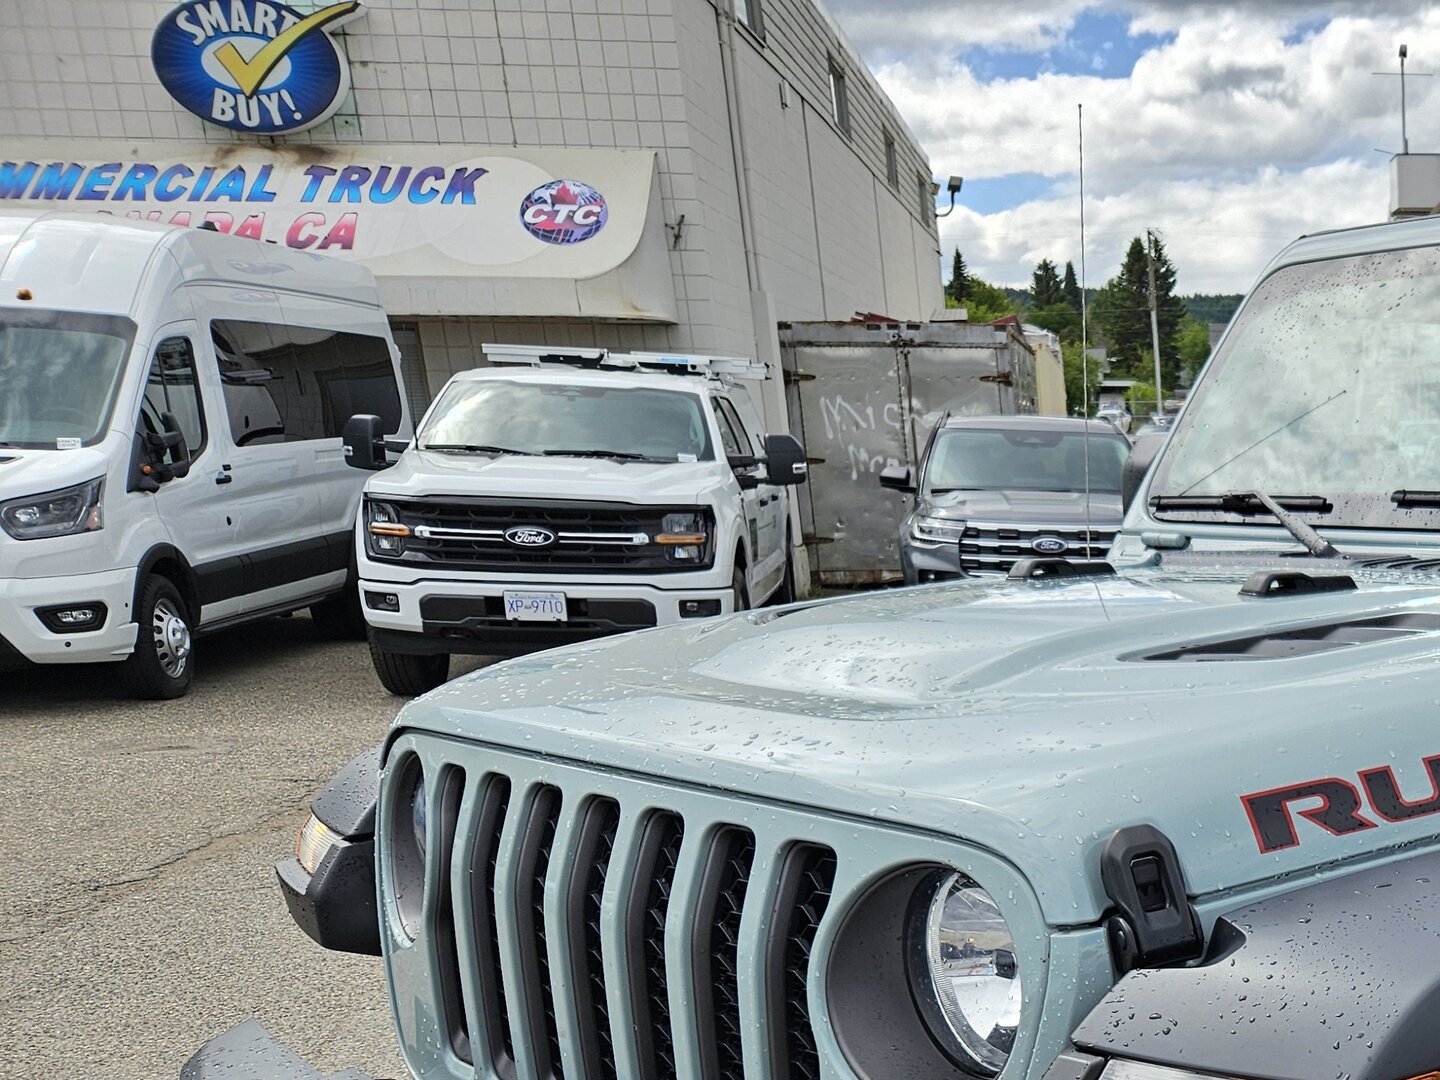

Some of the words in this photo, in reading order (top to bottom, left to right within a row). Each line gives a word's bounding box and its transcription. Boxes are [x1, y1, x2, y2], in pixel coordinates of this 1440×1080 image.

[176, 1, 300, 46] SMART
[211, 88, 302, 127] BUY!
[300, 154, 489, 204] TRUCK
[524, 203, 602, 225] CTC
